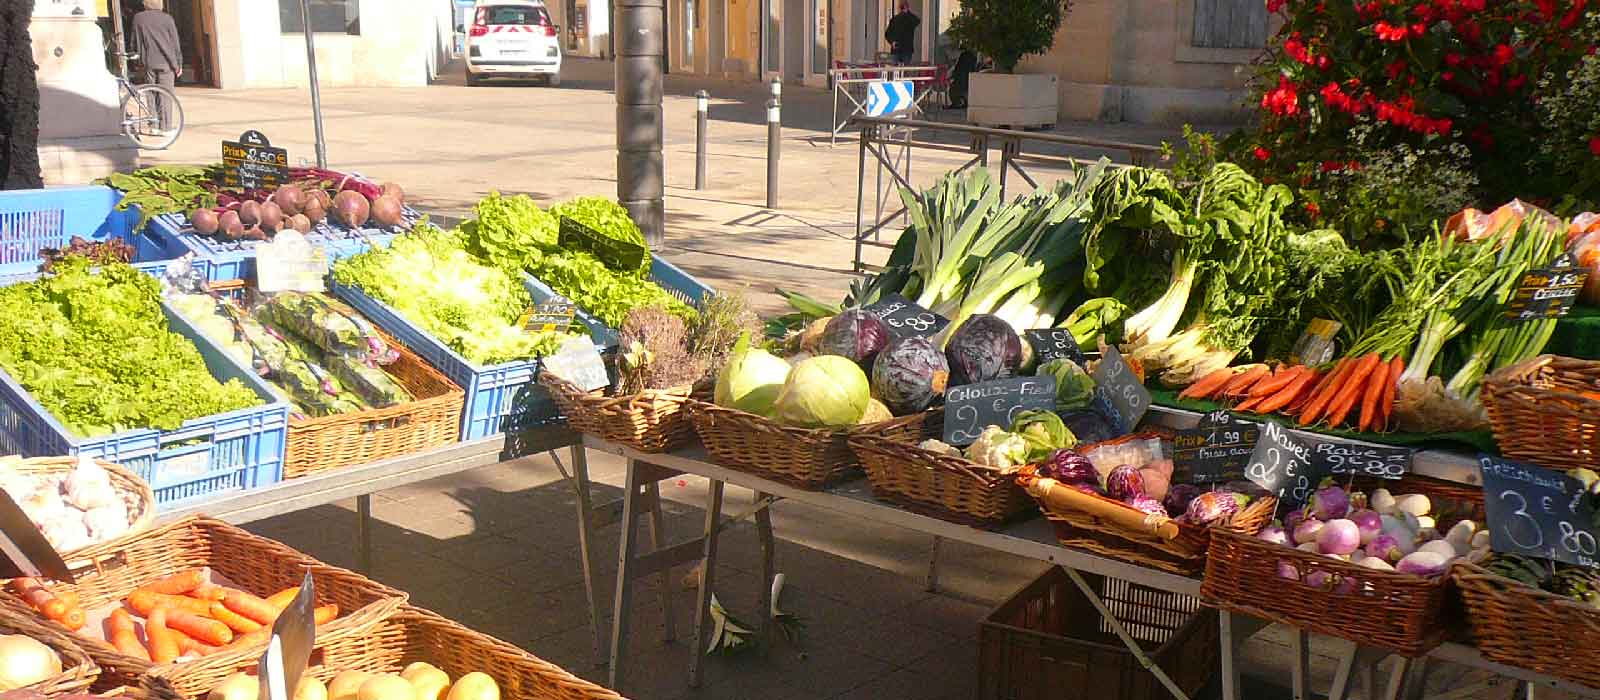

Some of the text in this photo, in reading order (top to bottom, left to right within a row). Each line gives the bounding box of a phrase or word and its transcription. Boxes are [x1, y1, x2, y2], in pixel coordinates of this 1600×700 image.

[223, 144, 241, 157] Prix
[1265, 421, 1312, 465] Navet
[1499, 489, 1544, 550] 3
